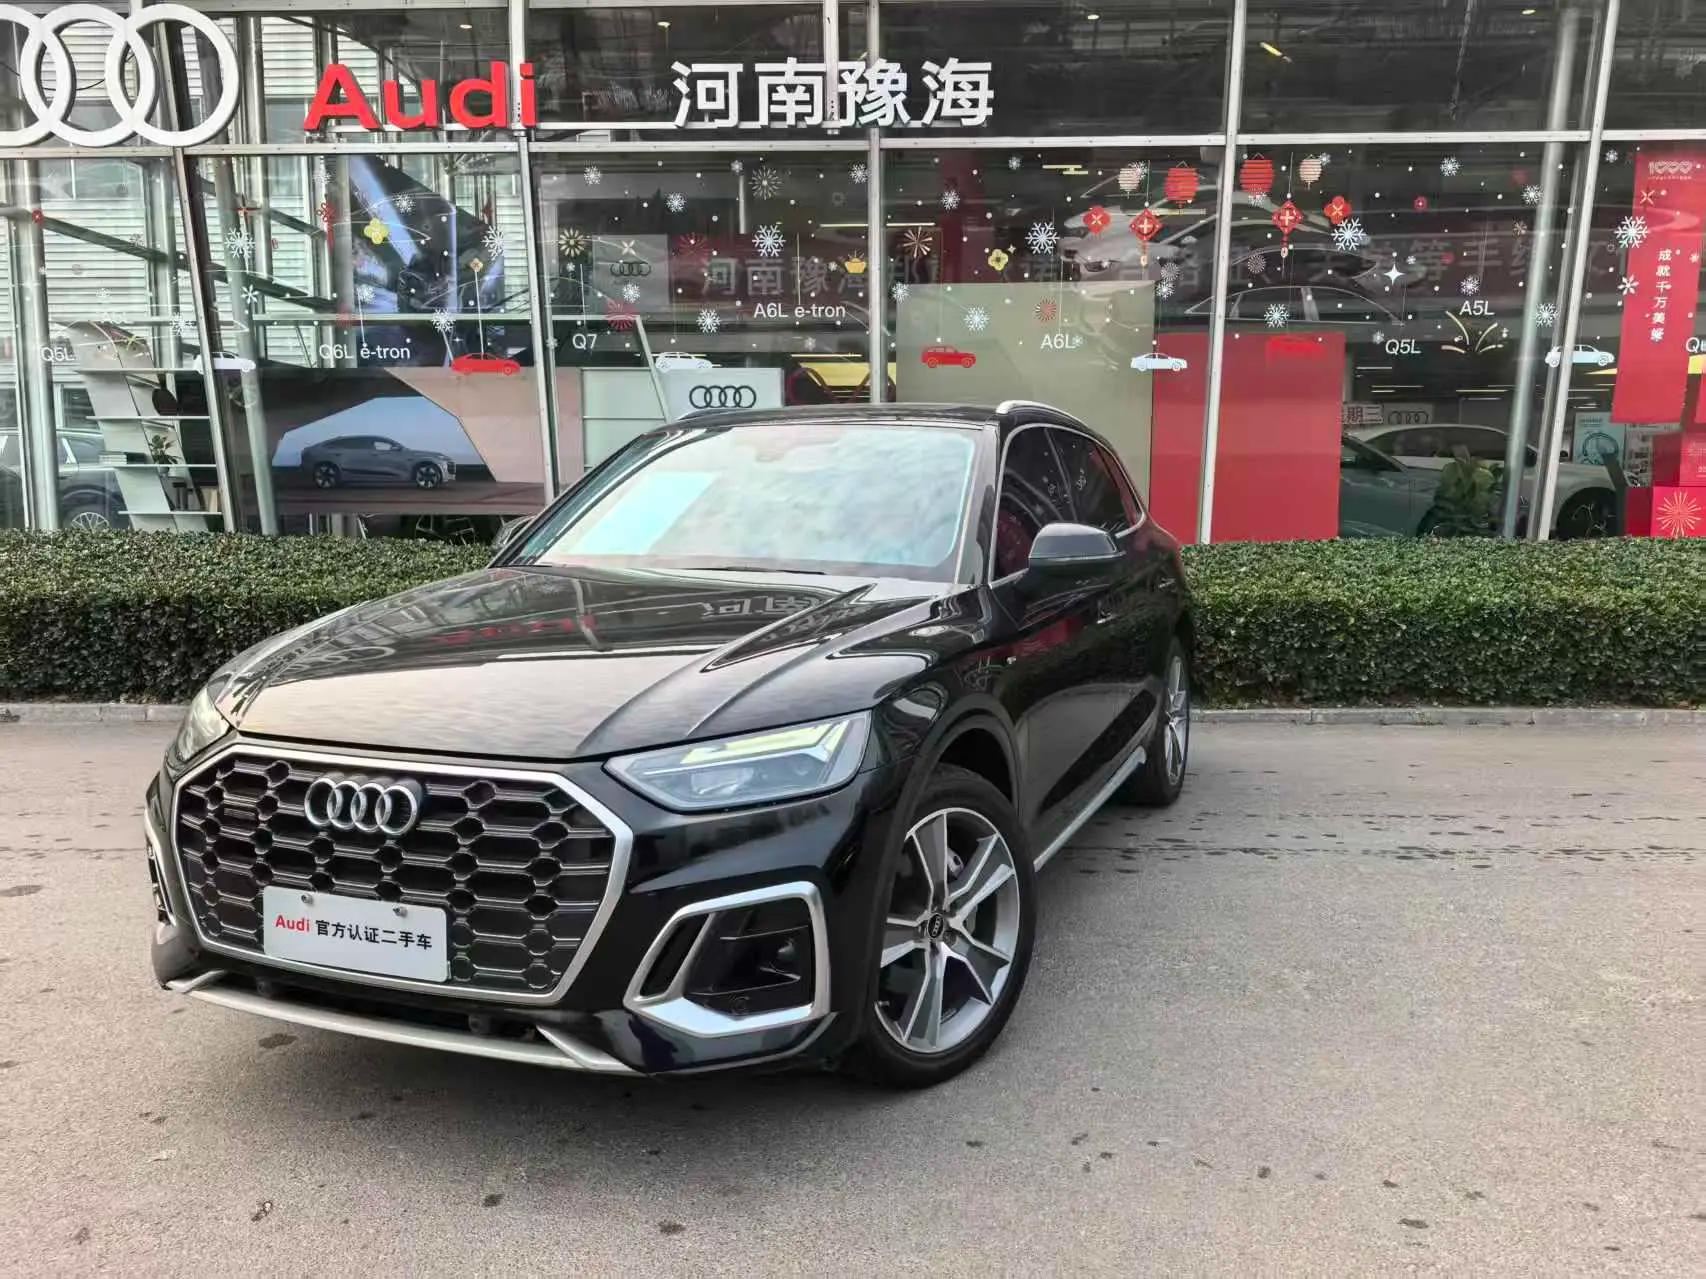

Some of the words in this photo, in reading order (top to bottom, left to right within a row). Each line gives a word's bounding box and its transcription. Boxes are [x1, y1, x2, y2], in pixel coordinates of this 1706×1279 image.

[303, 60, 537, 131] Audi
[671, 57, 994, 127] 河南豫海
[753, 302, 789, 318] A6L
[794, 303, 846, 318] e-tron
[1459, 300, 1495, 316] A5L
[572, 334, 598, 350] Q7
[1040, 334, 1076, 350] A6L
[1385, 339, 1422, 356] Q5L
[1686, 337, 1706, 353] Q
[319, 344, 354, 360] Q6L
[360, 345, 411, 360] e-tron
[1342, 406, 1383, 423] 期三
[275, 915, 311, 933] Audi
[315, 919, 433, 950] 官方认证二手车
